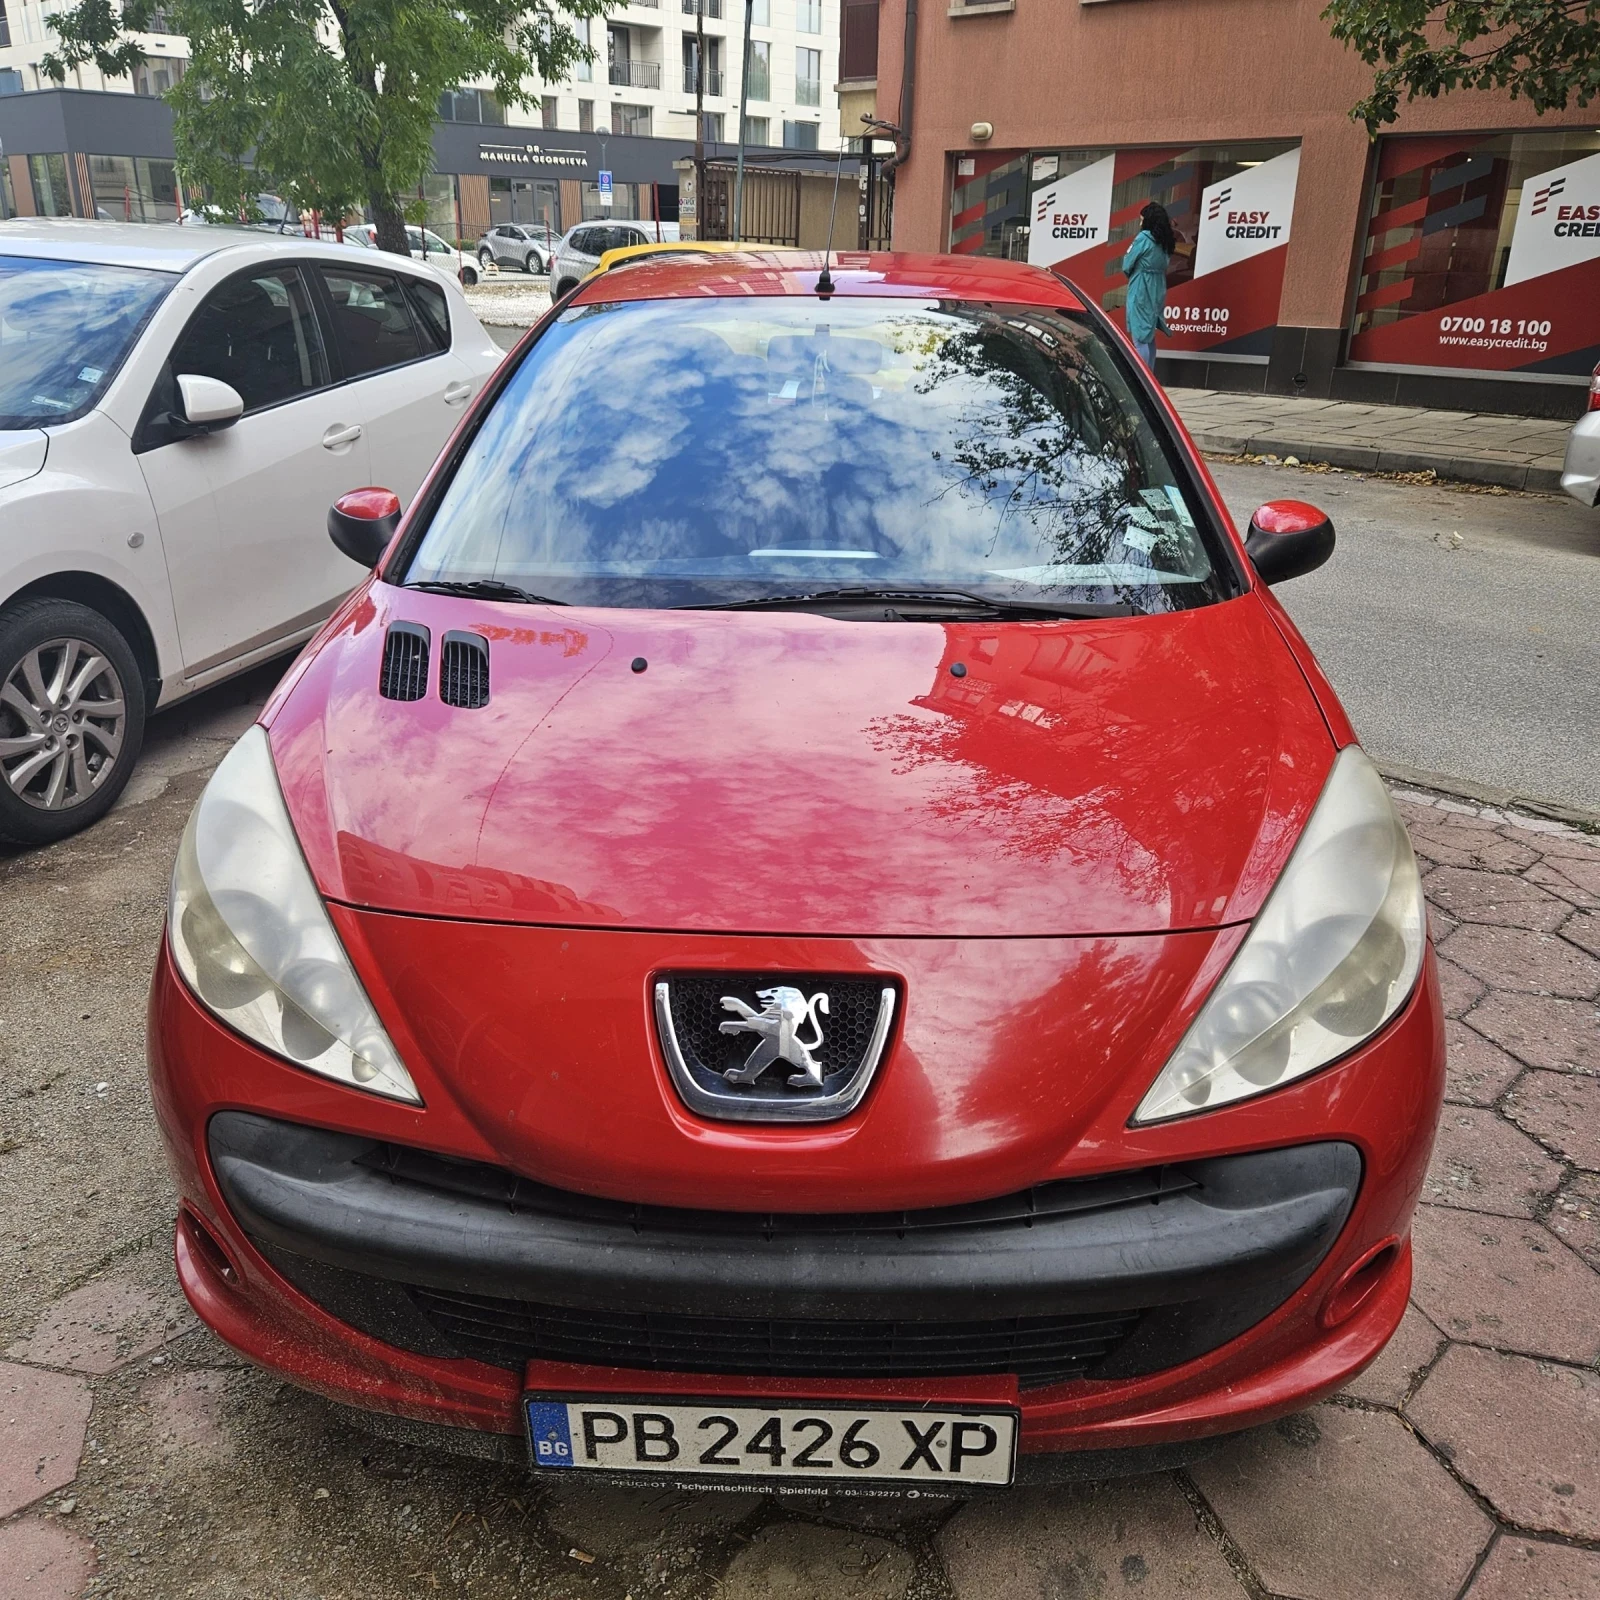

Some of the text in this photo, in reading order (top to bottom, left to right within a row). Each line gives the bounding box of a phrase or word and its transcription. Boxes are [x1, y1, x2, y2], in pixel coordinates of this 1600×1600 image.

[525, 144, 544, 154] DR.
[480, 151, 588, 167] MANUELA GEORGIEVA
[1053, 213, 1089, 226] EASY
[1227, 211, 1270, 225] EASY
[1557, 205, 1600, 221] EAS
[1052, 226, 1098, 239] CREDIT
[1225, 225, 1281, 239] CREDIT
[1554, 222, 1600, 237] CRE
[1163, 305, 1229, 322] 00 18 100
[1166, 323, 1227, 336] .easycredit.bg
[1440, 316, 1551, 336] 0700 18 100
[1439, 335, 1548, 352] www.easycredit.bg
[538, 1439, 570, 1458] BG
[581, 1409, 998, 1474] PB 2426 XP
[779, 1486, 829, 1496] Spielfeld
